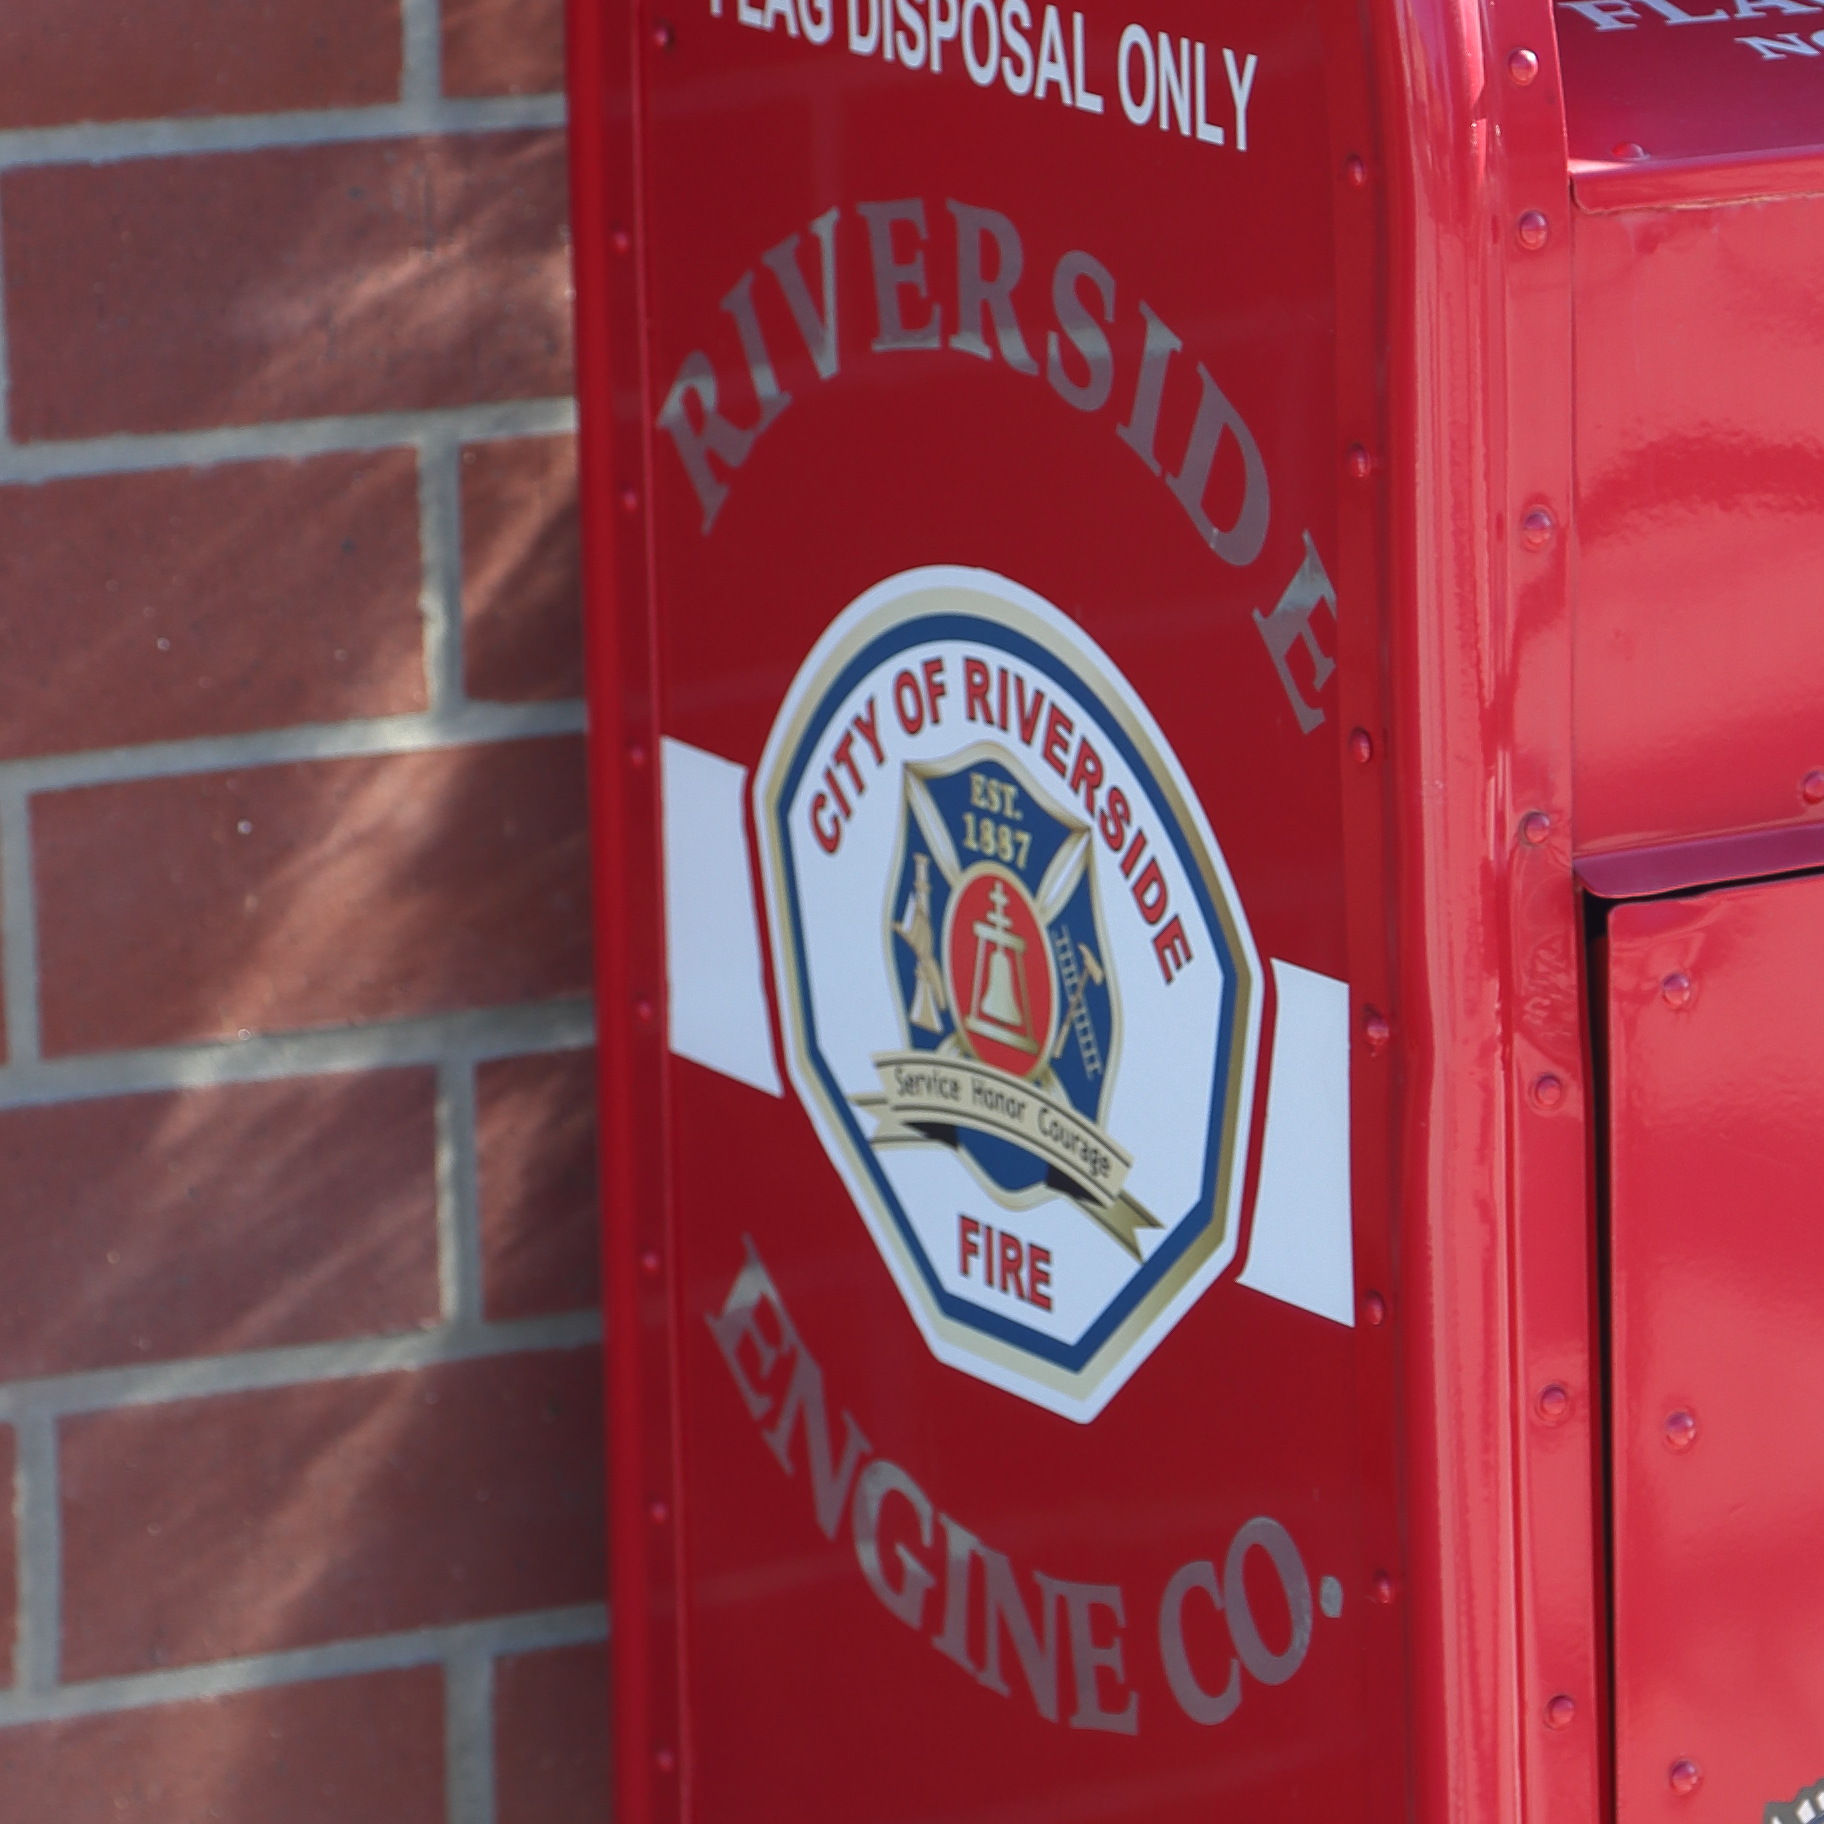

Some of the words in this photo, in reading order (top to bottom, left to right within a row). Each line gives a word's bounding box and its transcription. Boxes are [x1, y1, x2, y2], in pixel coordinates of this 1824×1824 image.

[1118, 23, 1258, 151] ONLY
[657, 197, 1337, 734] RIVERSIDE
[811, 698, 889, 854] CITY
[894, 659, 948, 735] OF
[964, 658, 1193, 987] RIVERSIDE
[962, 810, 1032, 866] 1887
[969, 773, 1023, 820] EST.
[894, 1064, 961, 1102] Service
[971, 1078, 1027, 1123] Honor
[1037, 1106, 1111, 1178] Courage
[958, 1214, 1053, 1312] FIRE
[705, 1232, 1139, 1736] ENGINE
[1159, 1515, 1343, 1726] CO.
